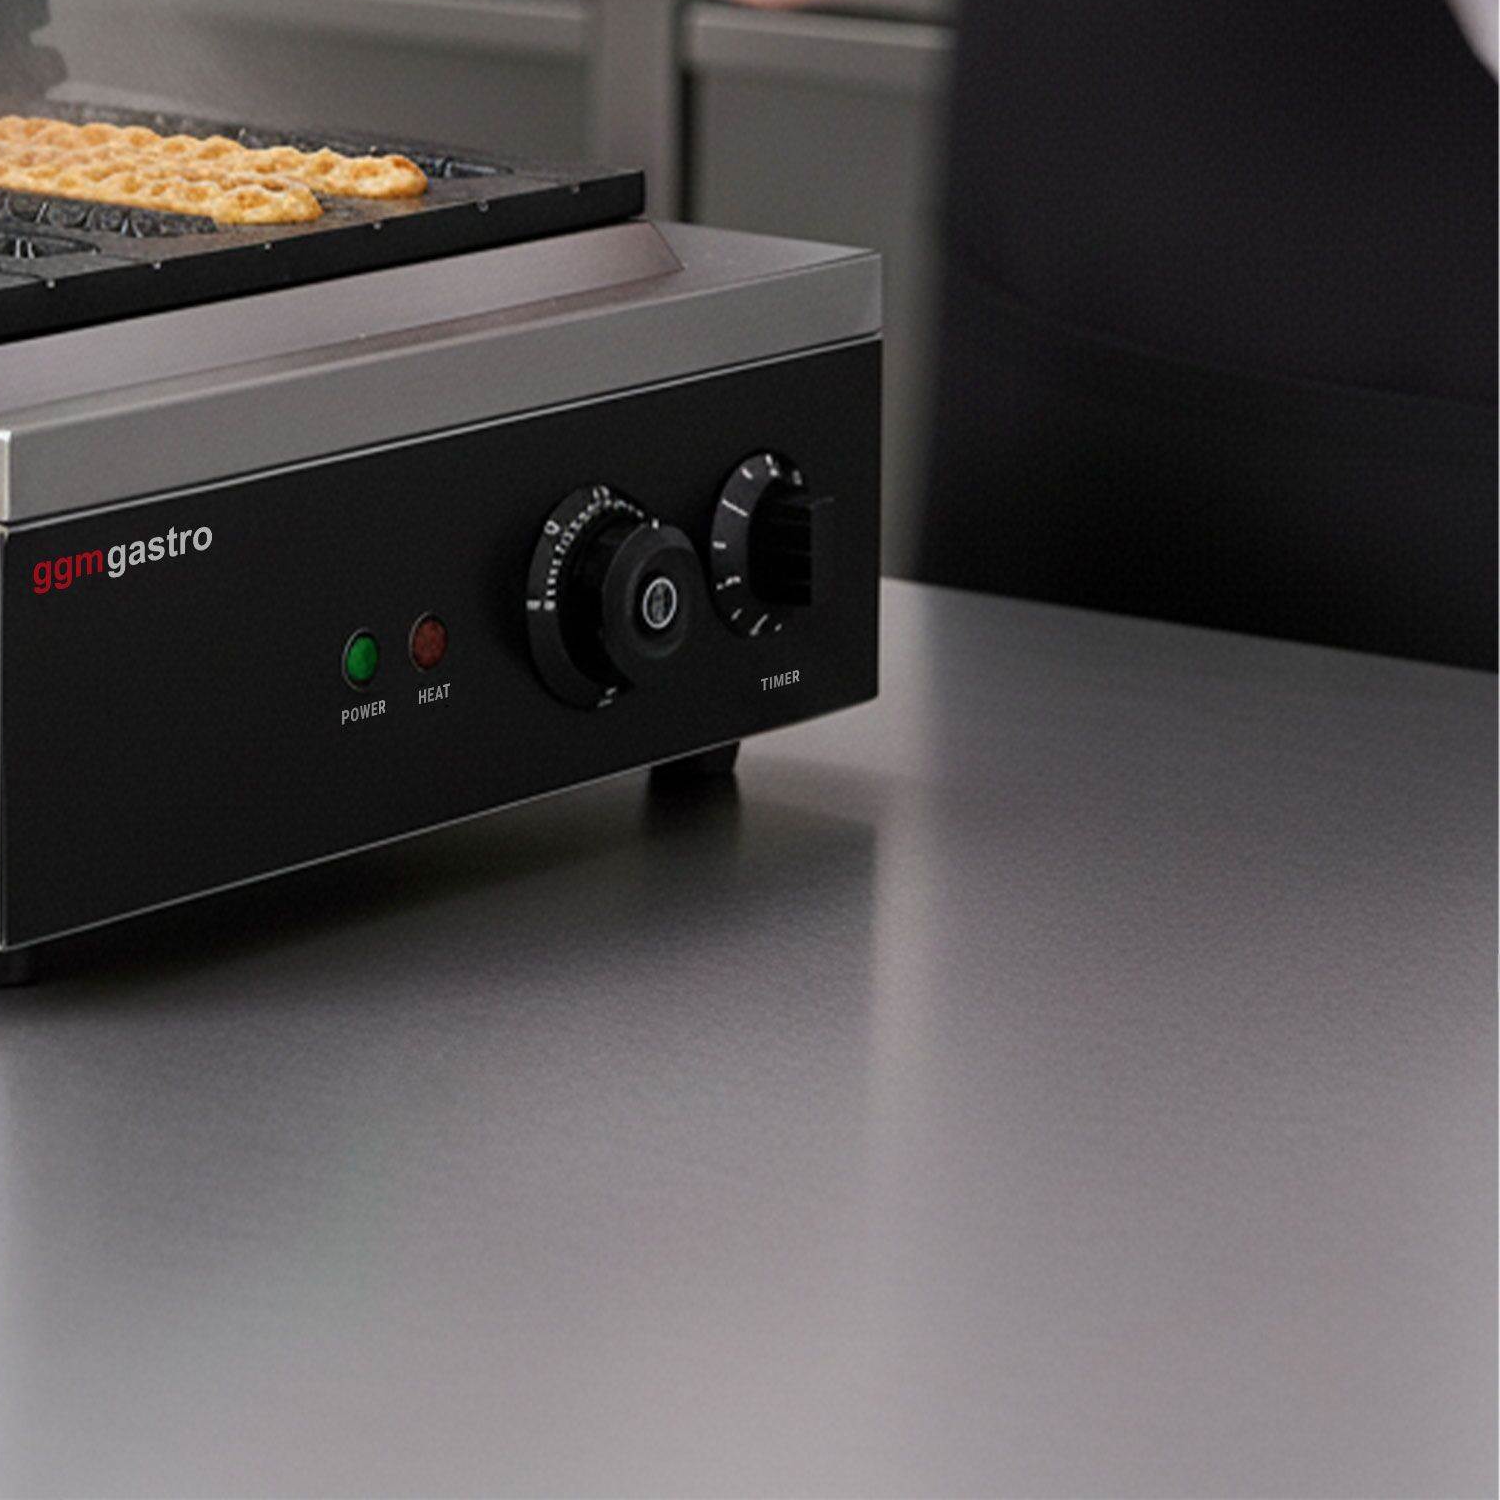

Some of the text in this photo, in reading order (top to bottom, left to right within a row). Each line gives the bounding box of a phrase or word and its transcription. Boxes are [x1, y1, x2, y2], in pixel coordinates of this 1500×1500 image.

[33, 526, 213, 594] ggmgastro
[760, 669, 800, 691] TIMER
[418, 683, 451, 705] HEAT
[341, 699, 386, 725] POWER
